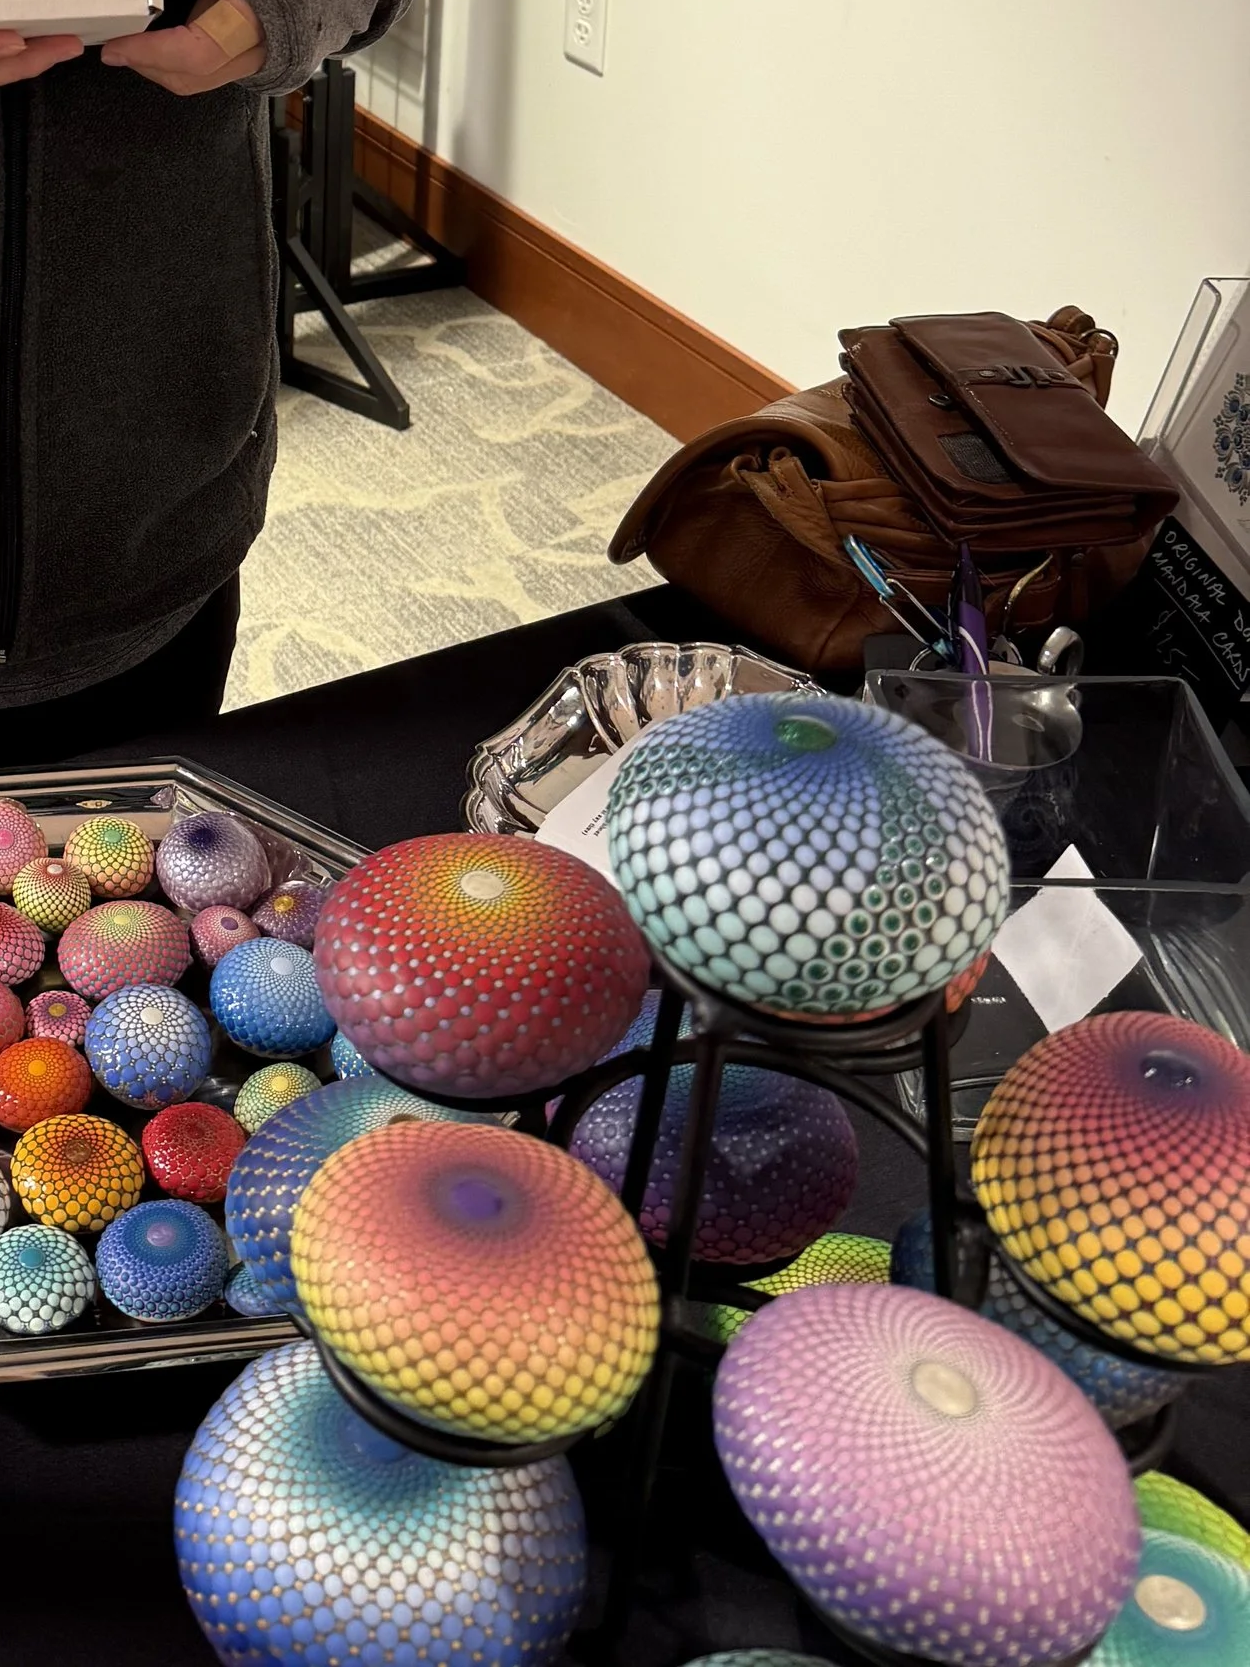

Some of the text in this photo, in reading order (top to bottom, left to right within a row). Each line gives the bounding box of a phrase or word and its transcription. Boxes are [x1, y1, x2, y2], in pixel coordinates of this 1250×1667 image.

[1152, 552, 1250, 683] MANDALA CARDS
[1164, 530, 1250, 643] ORIGINAL DO
